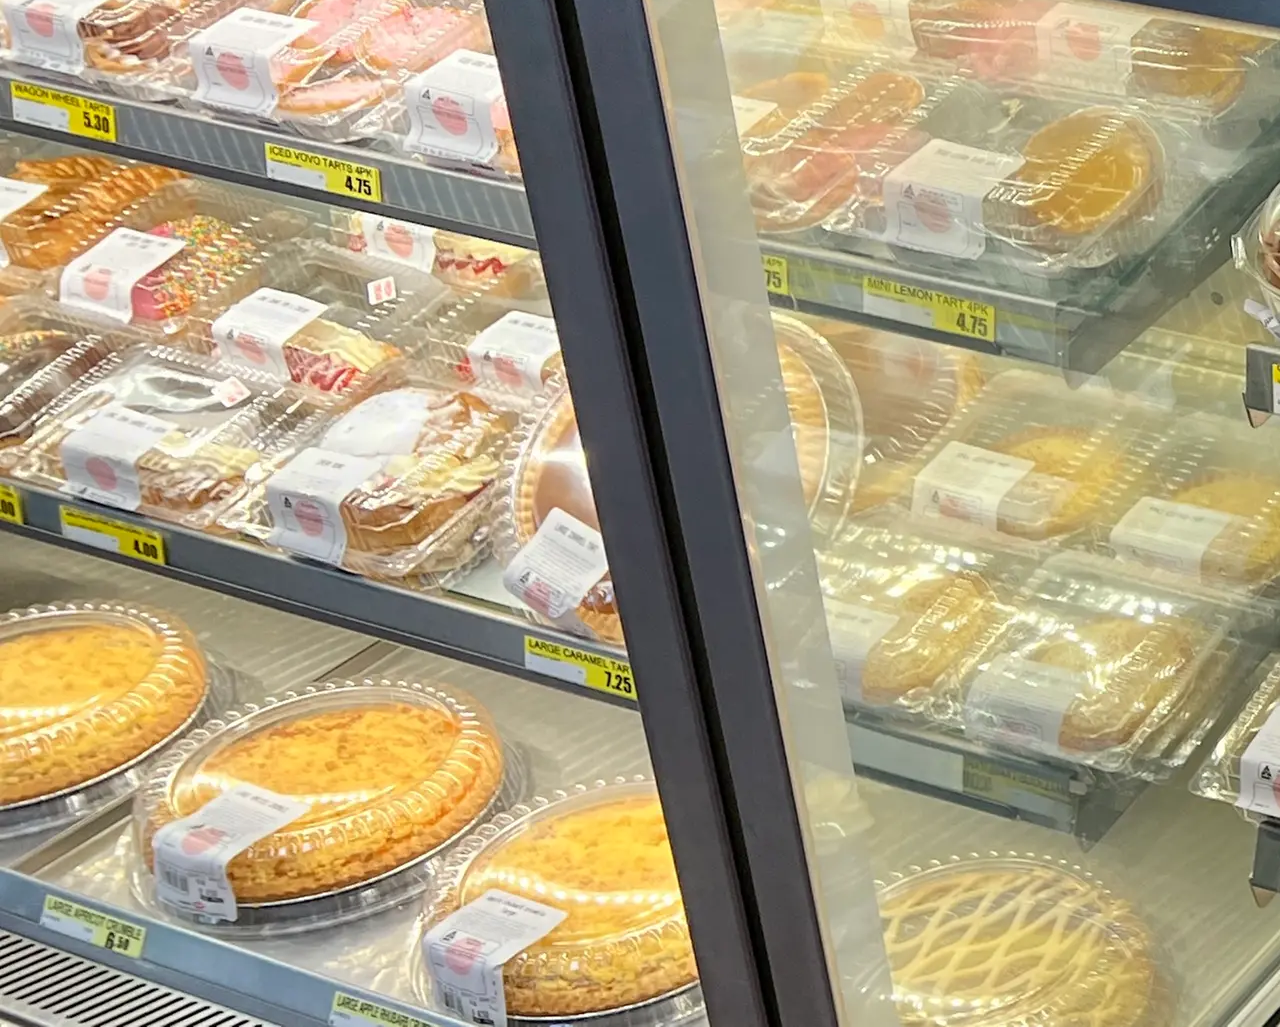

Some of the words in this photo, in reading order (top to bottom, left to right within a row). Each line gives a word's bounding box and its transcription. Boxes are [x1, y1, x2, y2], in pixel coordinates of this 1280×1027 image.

[14, 85, 49, 98] WAGON
[51, 92, 81, 107] WHEEL
[83, 100, 110, 115] TARTS
[83, 111, 109, 134] 5.30
[269, 146, 291, 158] ICED
[294, 151, 320, 165] VOVO
[323, 158, 352, 173] TARTS
[355, 167, 372, 178] 4PK
[345, 176, 371, 196] 4.75
[867, 277, 892, 292] MINI
[893, 285, 933, 302] LEMON
[935, 294, 964, 311] TART
[966, 302, 988, 316] 4PK
[956, 312, 988, 337] 4.75
[134, 540, 157, 560] 4.00
[528, 639, 560, 655] LARGE
[563, 647, 608, 668] CARAMEL
[610, 659, 630, 674] TAR
[605, 671, 632, 693] 7.25
[47, 898, 73, 917] LARGE
[337, 994, 360, 1012] LARGE
